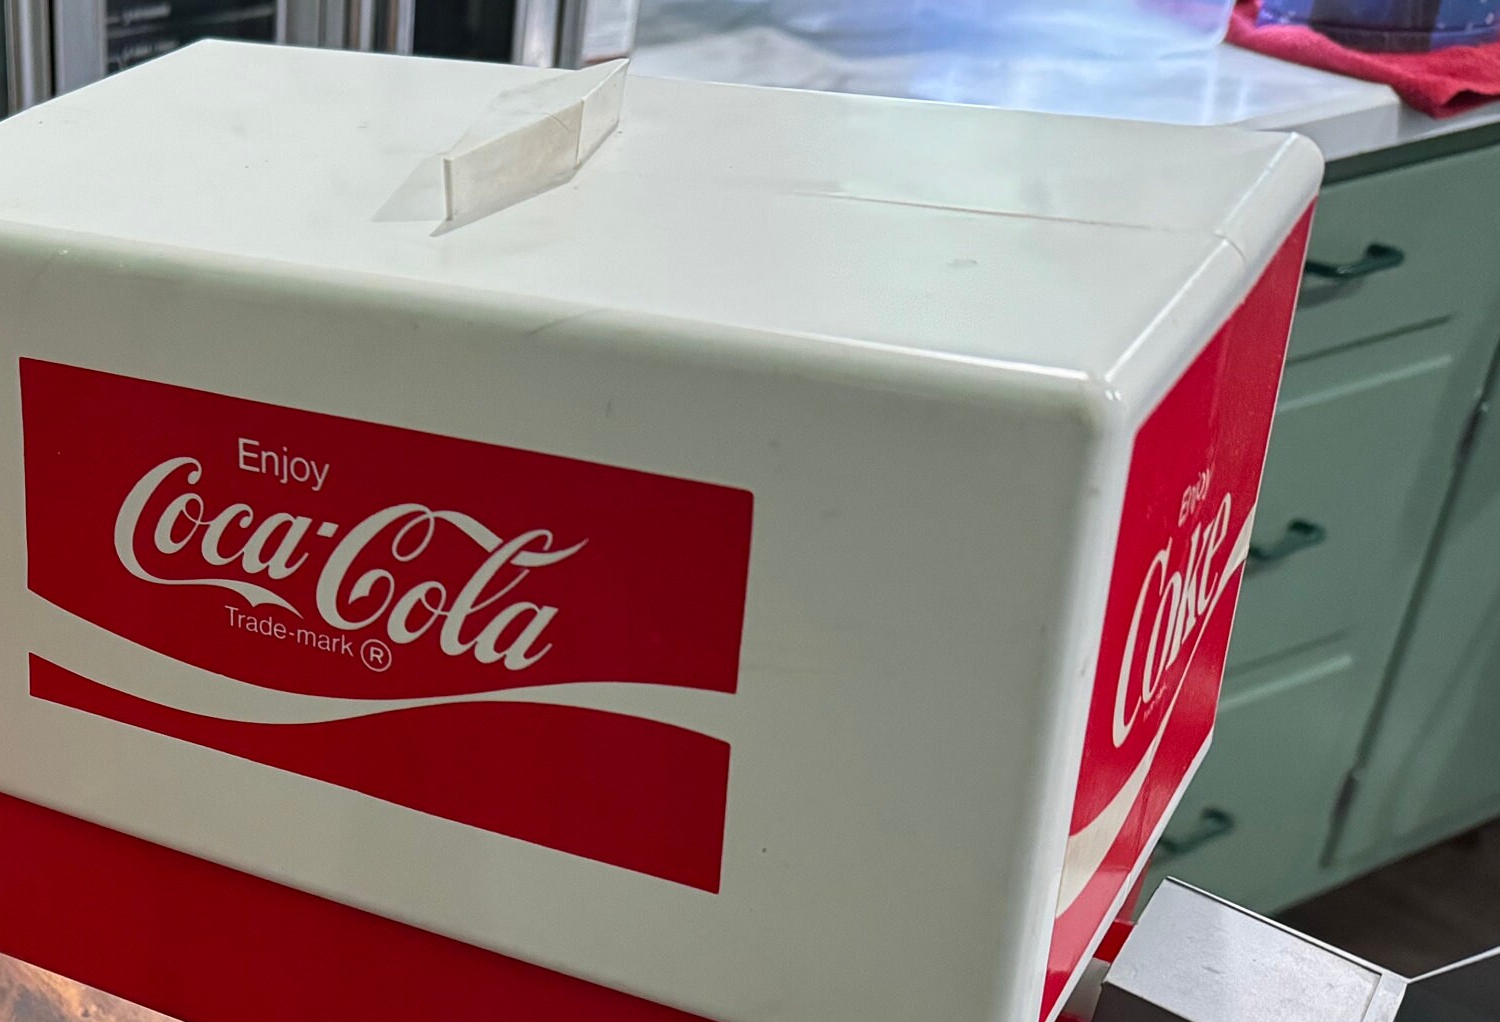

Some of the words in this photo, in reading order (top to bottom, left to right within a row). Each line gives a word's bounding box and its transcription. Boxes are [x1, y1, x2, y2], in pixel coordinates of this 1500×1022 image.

[238, 438, 329, 490] Enjoy
[114, 457, 589, 670] Coca-Cola
[1112, 492, 1232, 748] Coke
[224, 605, 355, 656] Trade-mark
